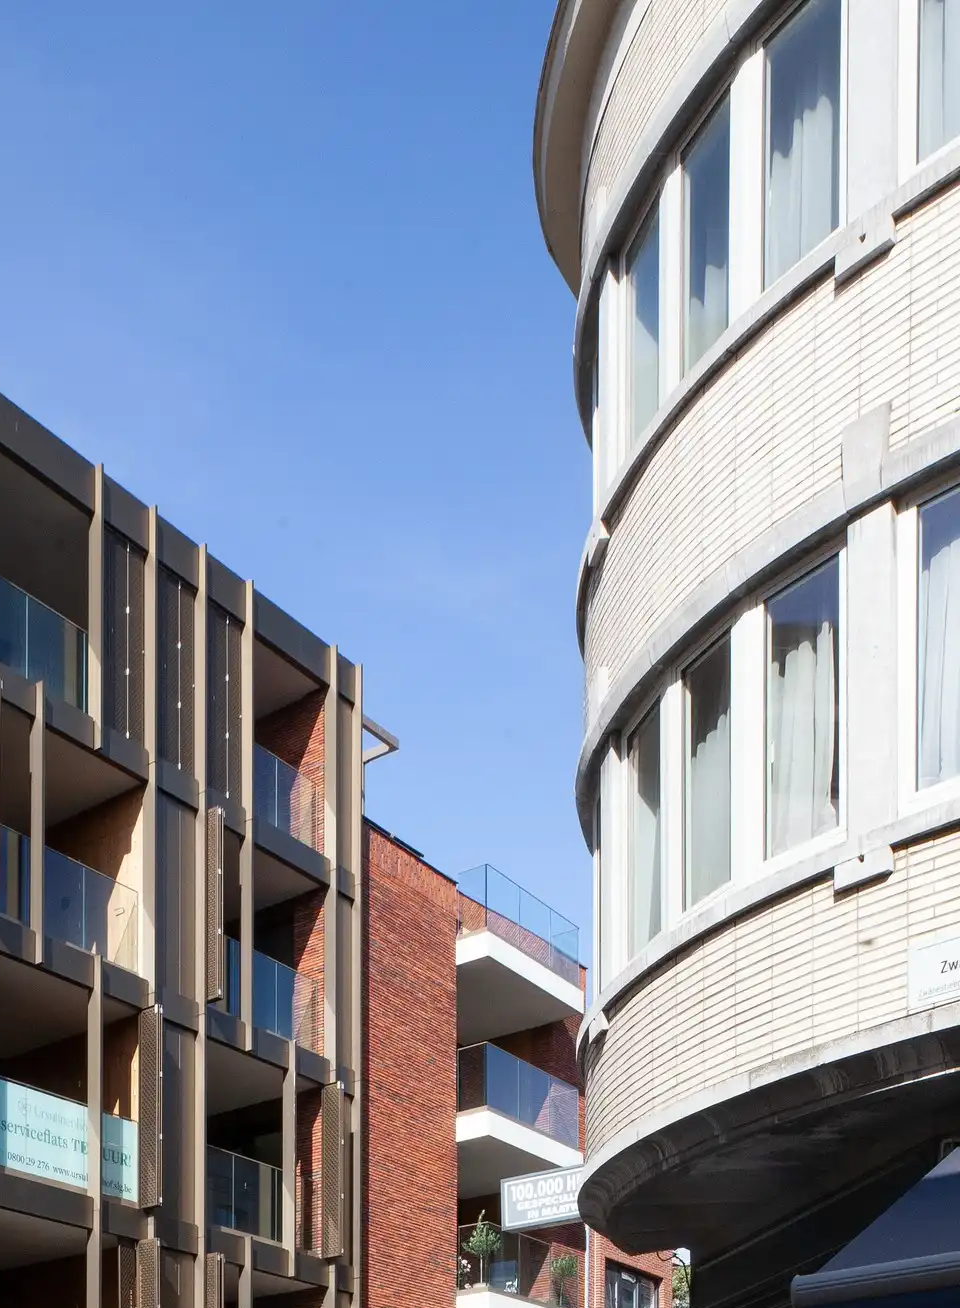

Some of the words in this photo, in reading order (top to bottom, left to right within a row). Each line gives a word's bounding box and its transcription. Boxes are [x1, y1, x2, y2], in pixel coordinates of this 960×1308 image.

[940, 960, 960, 974] Zw
[7, 1151, 25, 1165] 0800
[25, 1156, 36, 1168] 29
[37, 1159, 50, 1171] 276
[102, 1147, 132, 1168] UUR!
[510, 1176, 564, 1202] 100.000
